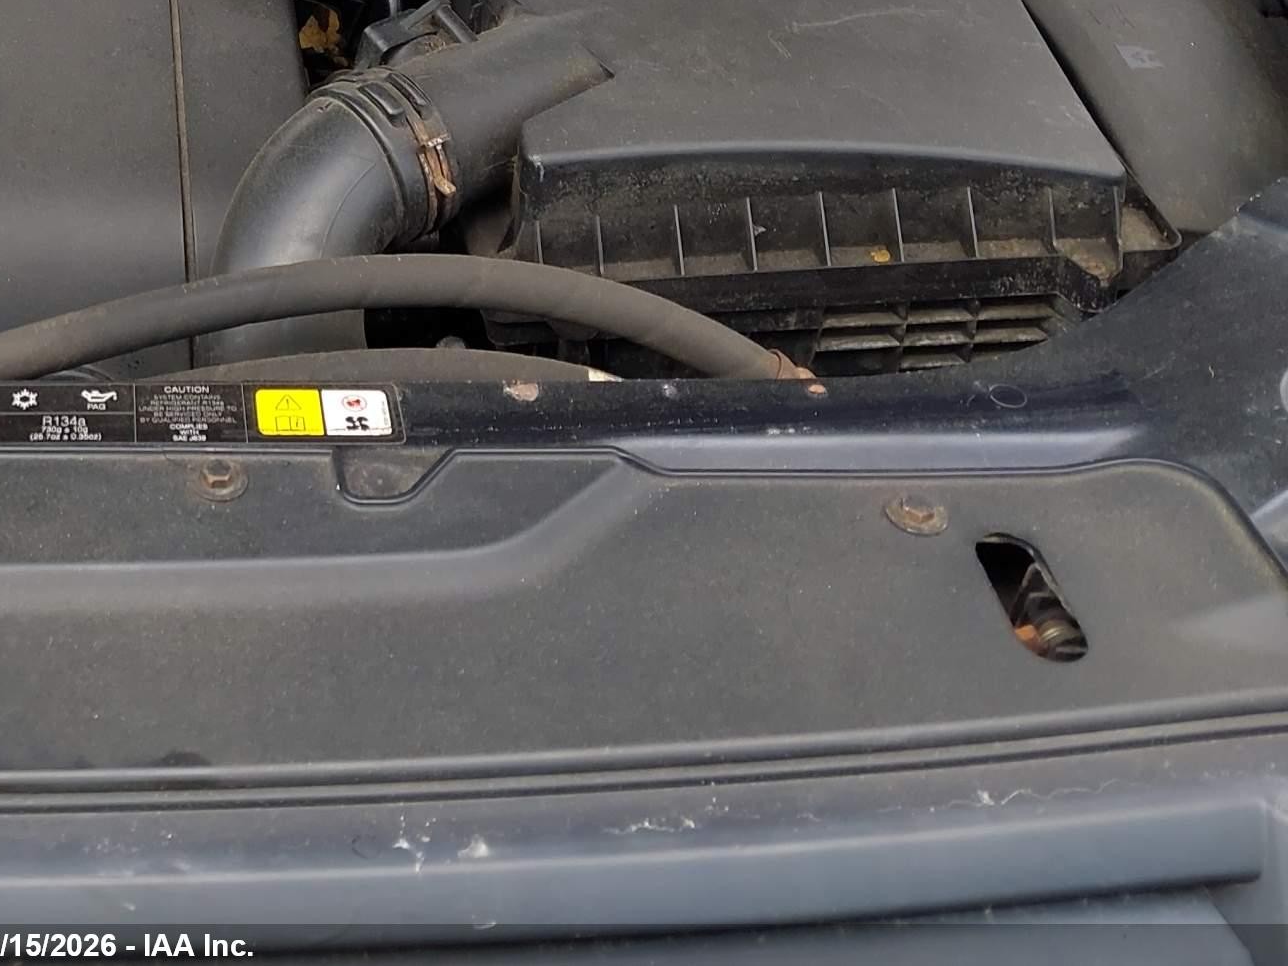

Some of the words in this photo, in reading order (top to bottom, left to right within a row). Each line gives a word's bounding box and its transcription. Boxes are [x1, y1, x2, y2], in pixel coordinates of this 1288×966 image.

[164, 386, 210, 394] CAUTION
[87, 403, 107, 411] PAG
[42, 416, 86, 427] R134a
[169, 423, 209, 431] COMPLIES
